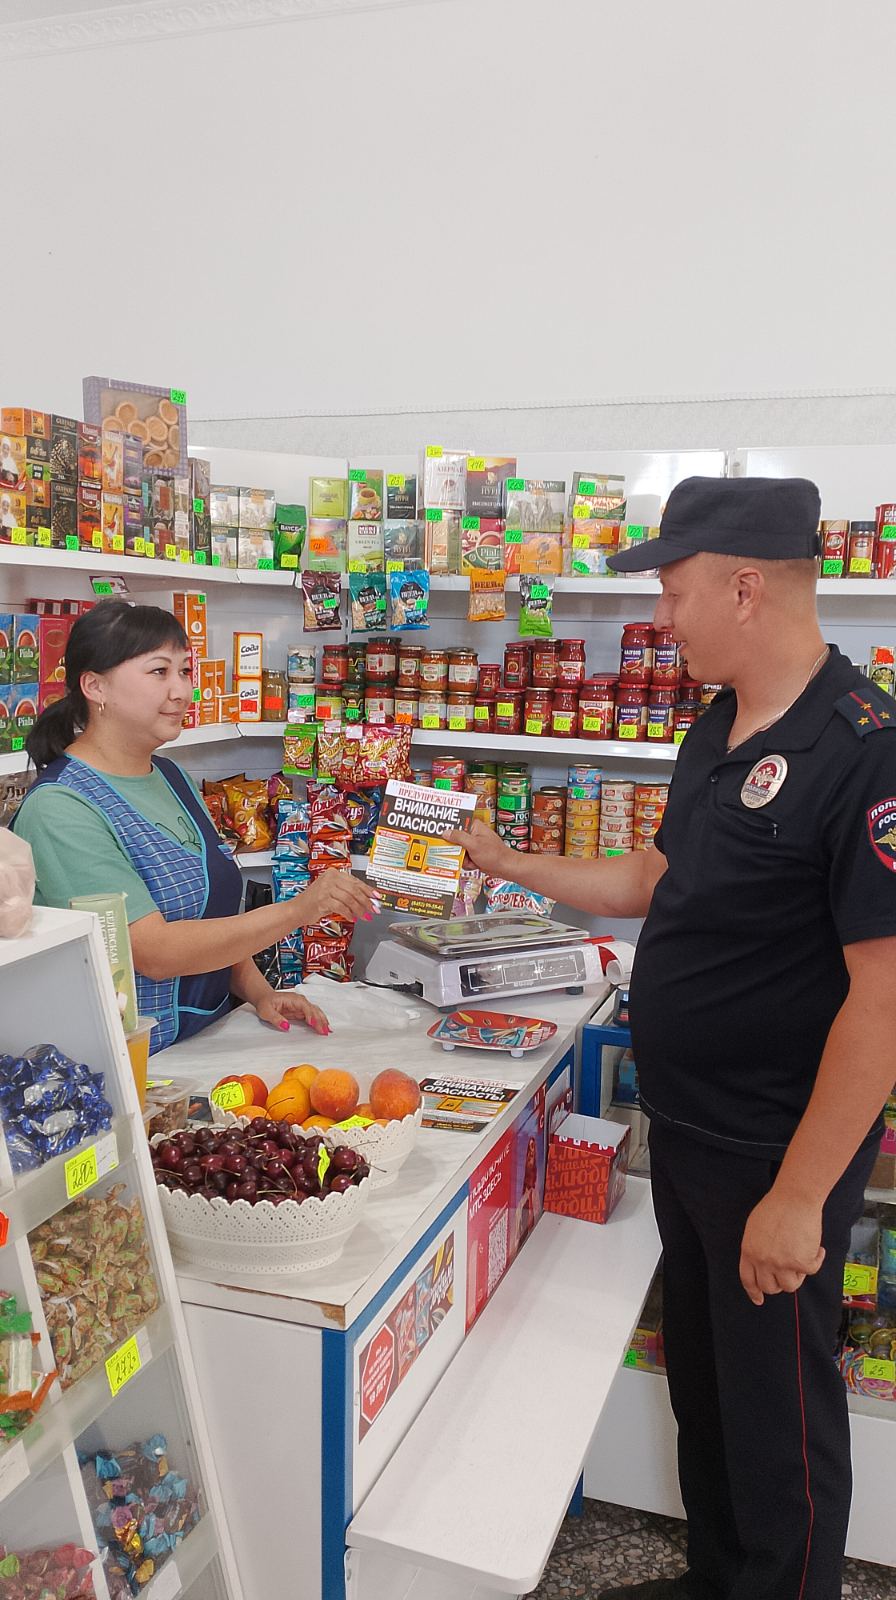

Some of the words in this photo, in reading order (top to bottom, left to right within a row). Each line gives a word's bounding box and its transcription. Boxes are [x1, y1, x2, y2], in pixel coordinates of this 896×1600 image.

[394, 799, 461, 824] ВНИМАНИЕ,
[424, 1085, 505, 1101] ОПАСНОСТЬ!
[433, 1080, 504, 1095] ВНИМАНИЕ,
